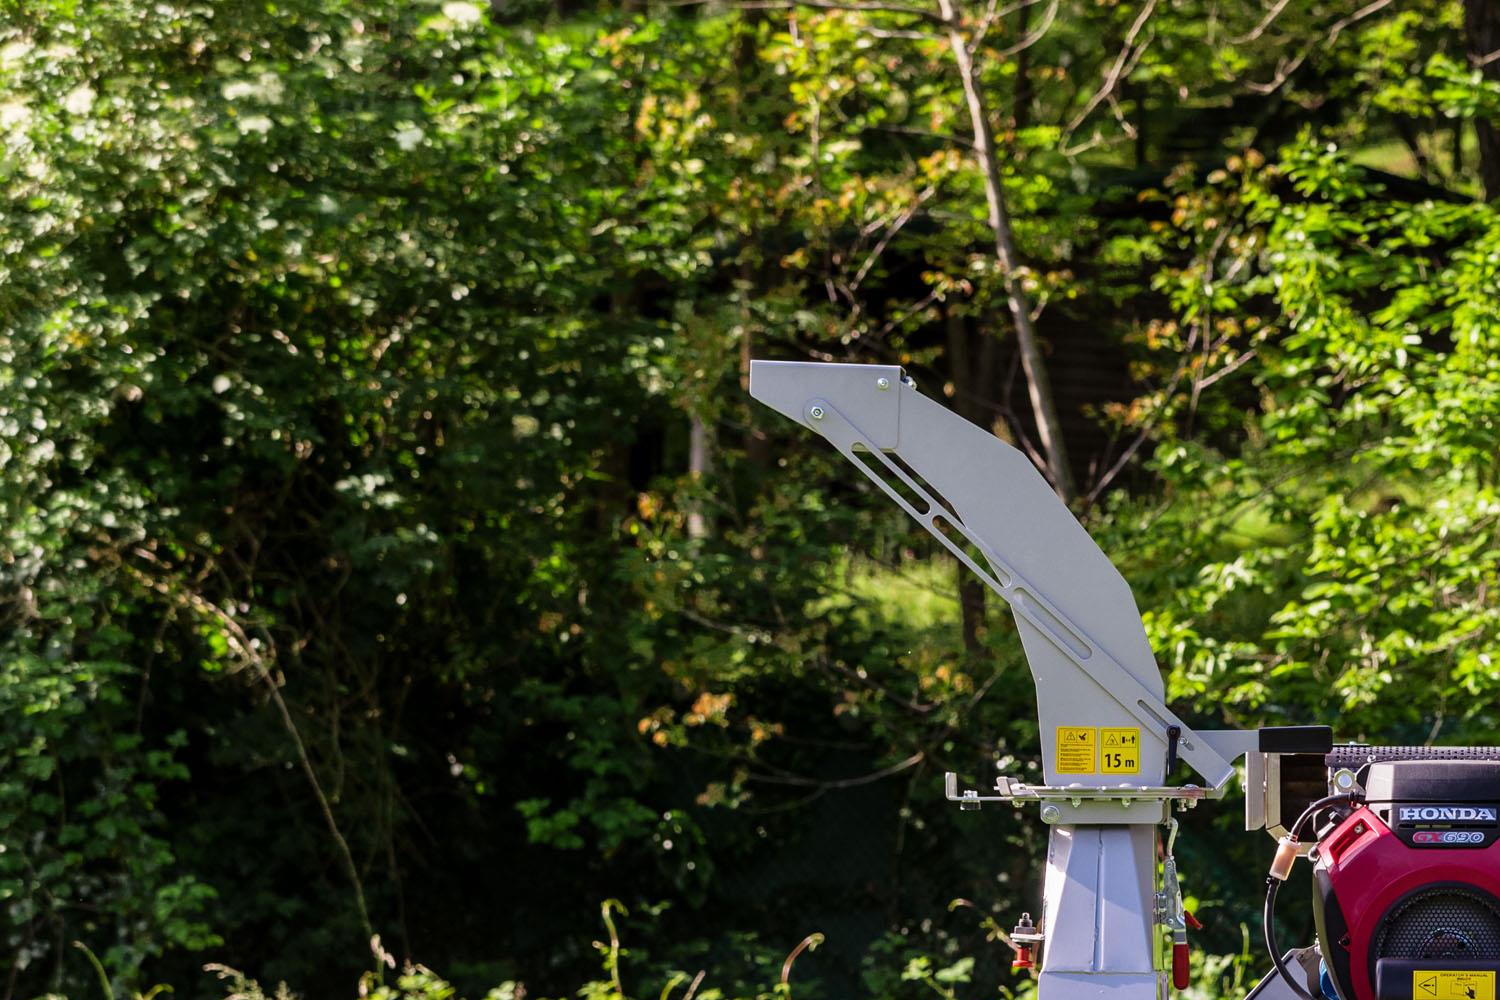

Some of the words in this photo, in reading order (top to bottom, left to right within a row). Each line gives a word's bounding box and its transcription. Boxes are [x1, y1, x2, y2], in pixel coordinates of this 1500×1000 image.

[1104, 754, 1121, 768] 15
[1125, 759, 1135, 768] m
[1400, 807, 1497, 821] HONDA
